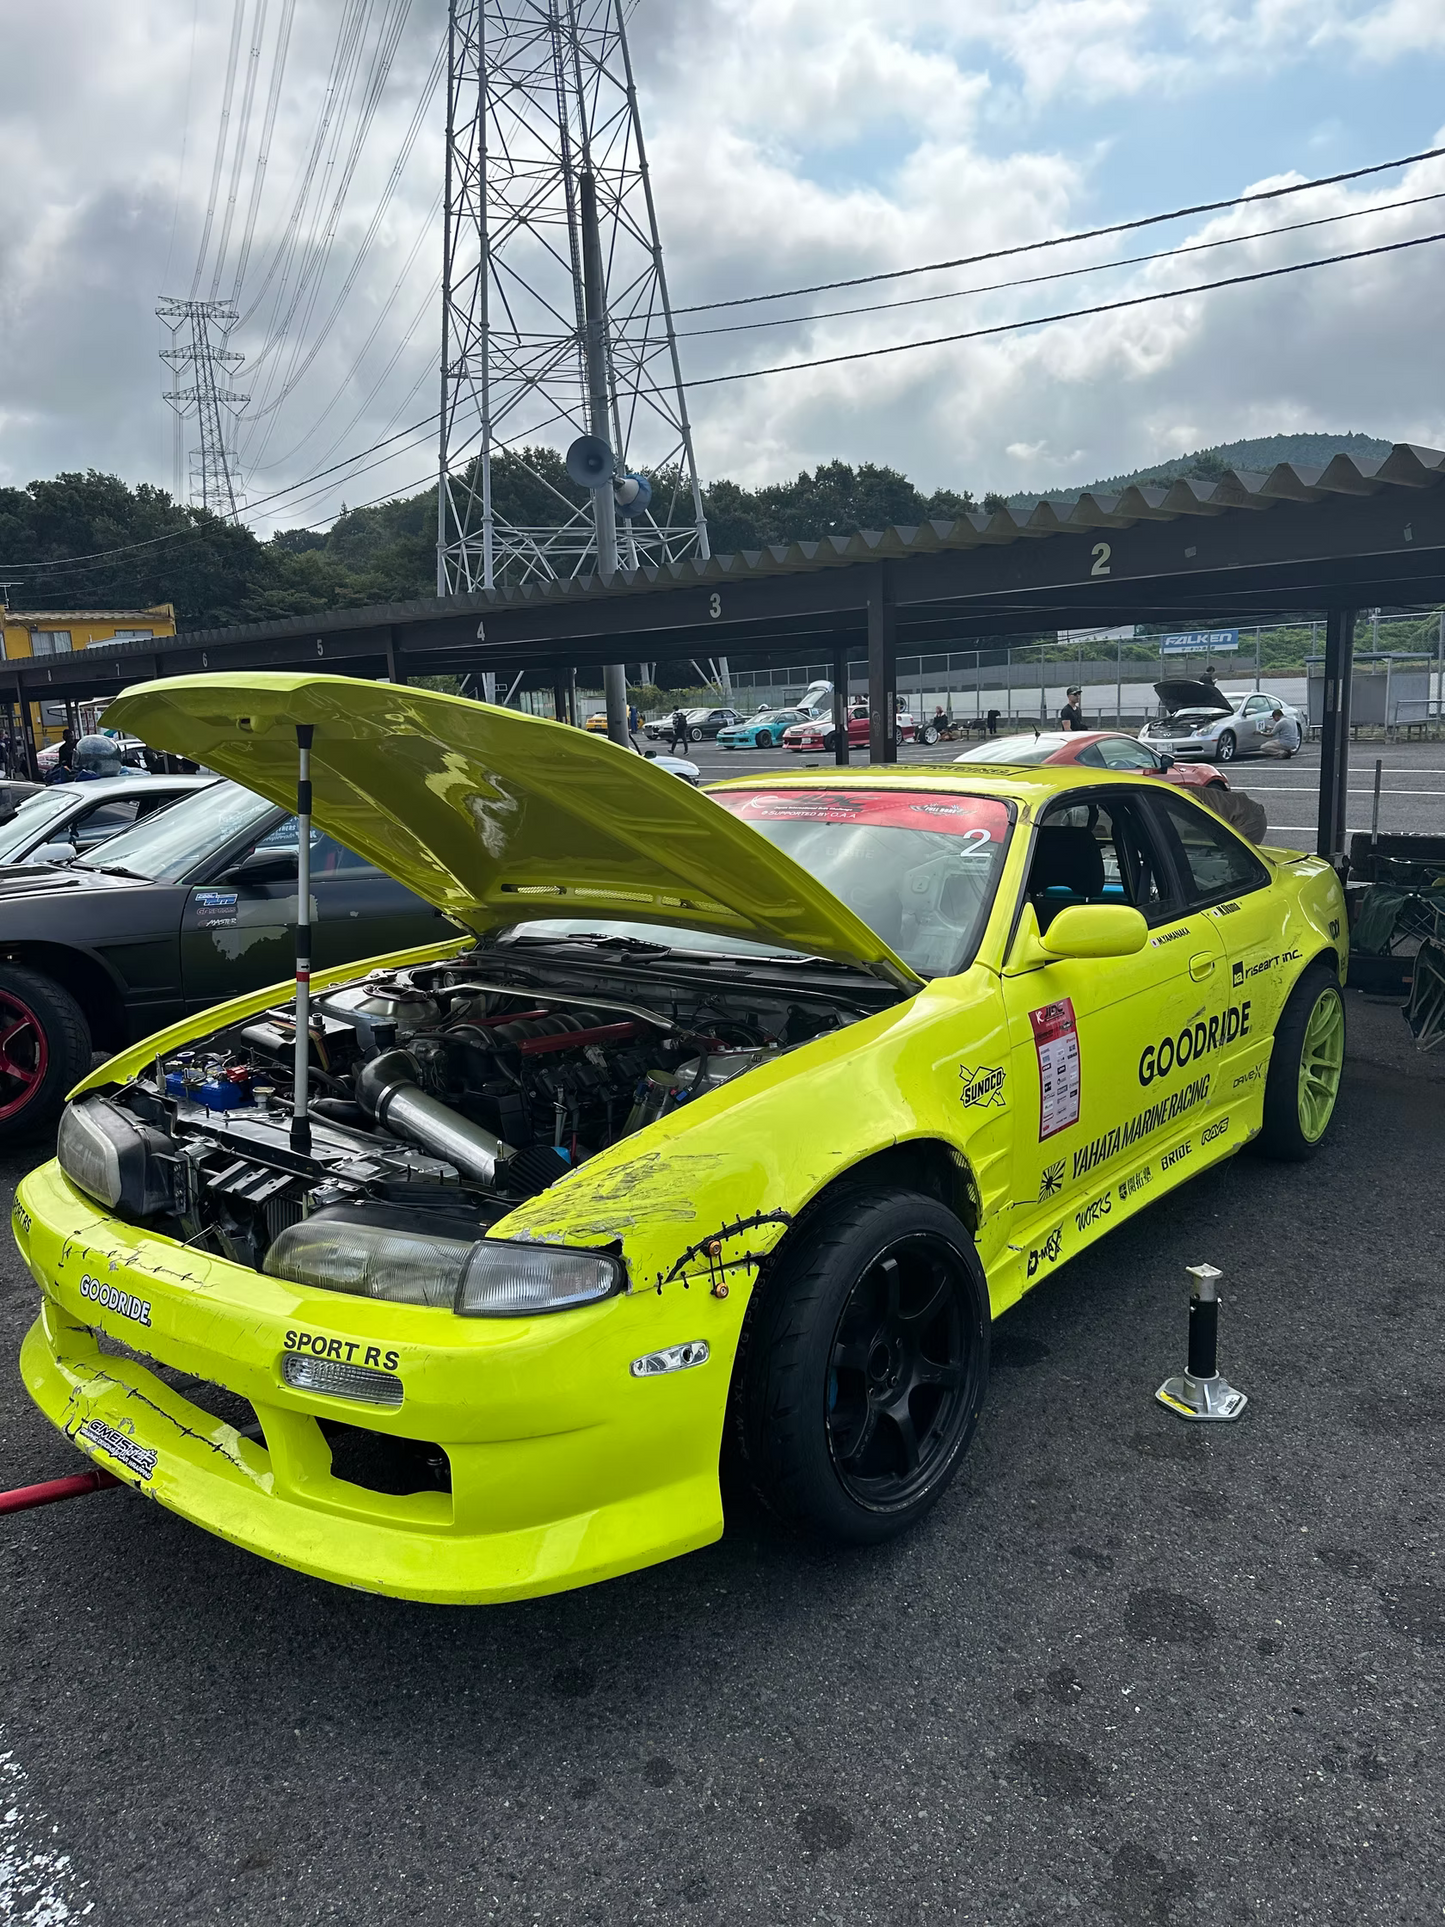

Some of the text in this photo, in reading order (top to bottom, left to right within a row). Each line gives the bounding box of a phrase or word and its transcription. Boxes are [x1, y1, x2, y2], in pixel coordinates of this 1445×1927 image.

[1091, 542, 1111, 575] 2
[709, 592, 722, 618] 3
[477, 621, 485, 641] 4
[1165, 633, 1233, 646] FALKEN
[202, 652, 209, 667] 6
[316, 639, 324, 656] 5
[960, 828, 992, 857] 2
[1138, 1000, 1251, 1087] GOODRIDE
[964, 1070, 1002, 1105] SUNOCO
[1072, 1073, 1210, 1180] YAHATA MARINE RACING
[1200, 1116, 1230, 1147] RAYS
[1160, 1139, 1193, 1171] BRIDE
[80, 1274, 153, 1328] GOODRIDE
[283, 1330, 400, 1371] SPORT RS
